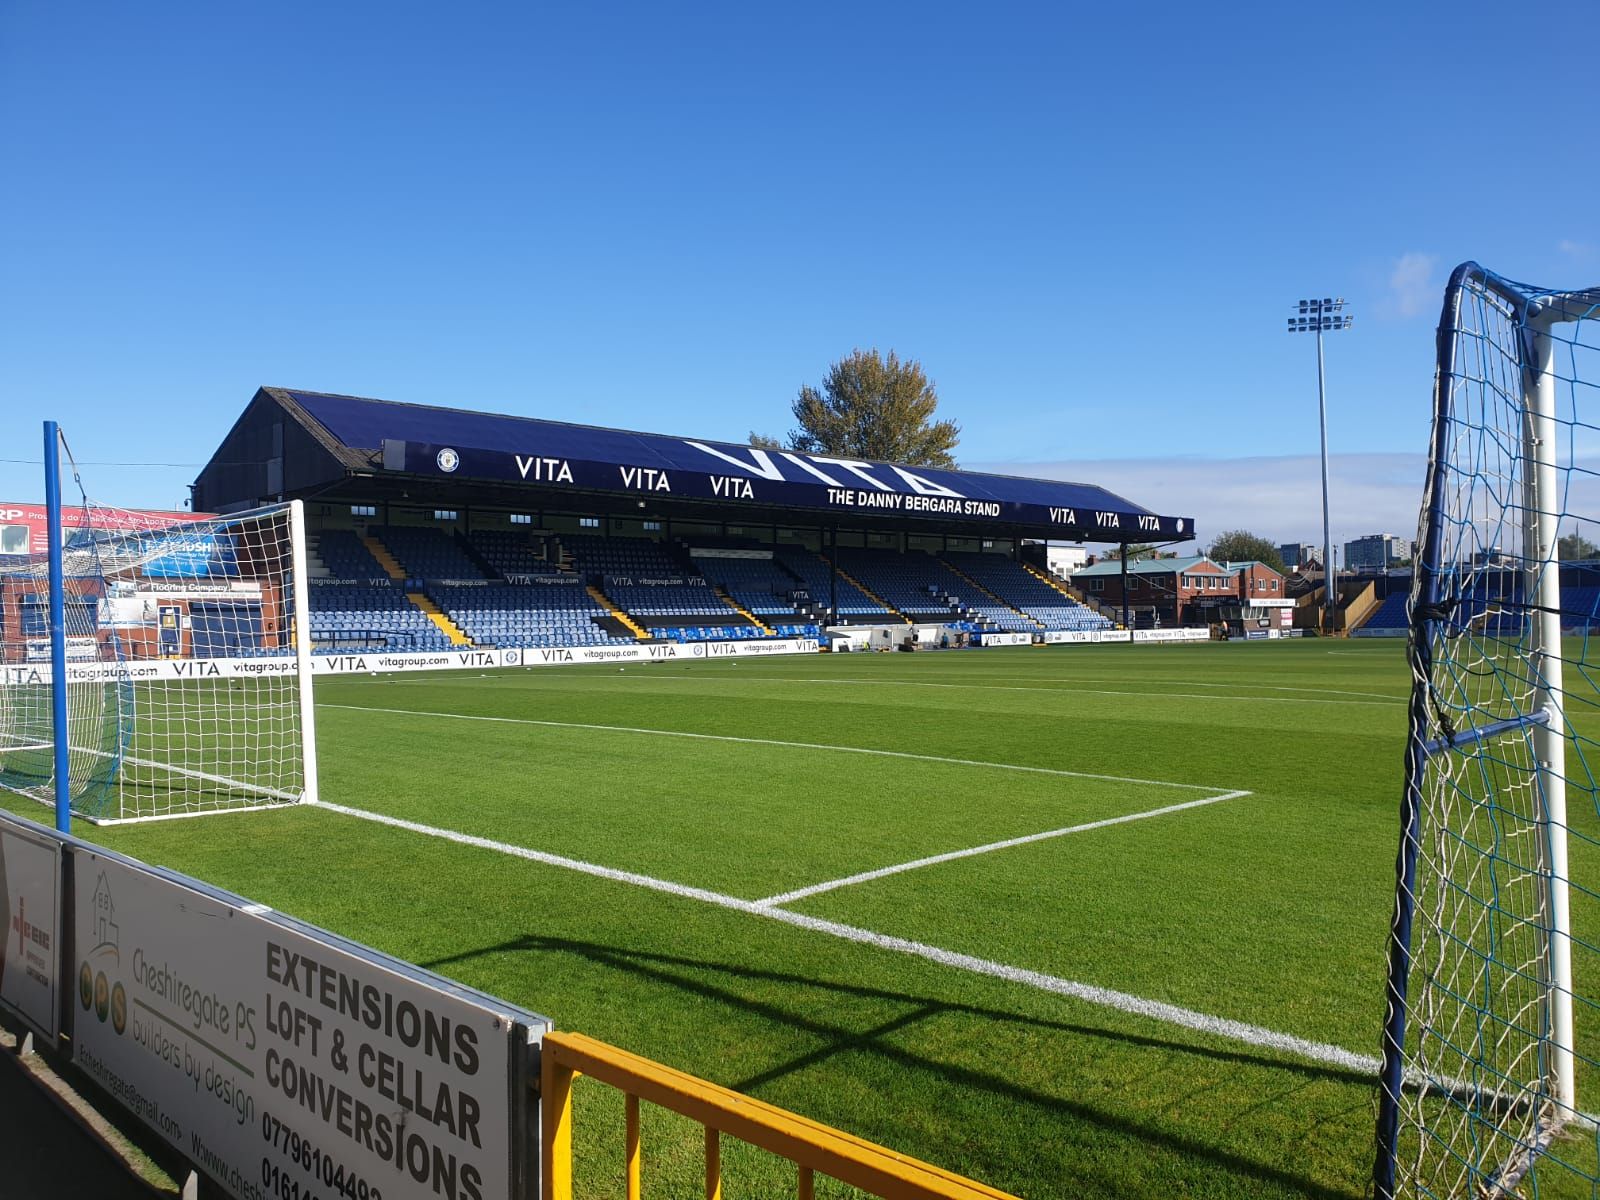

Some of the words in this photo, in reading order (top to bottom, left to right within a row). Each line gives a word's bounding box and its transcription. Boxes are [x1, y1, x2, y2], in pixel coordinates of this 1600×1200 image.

[515, 455, 574, 484] VITA
[683, 440, 968, 499] VITA
[619, 466, 671, 492] VITA
[709, 475, 754, 499] VITA
[827, 488, 854, 506] THE
[857, 491, 902, 509] DANNY
[904, 495, 963, 514] BERGARA
[964, 501, 1000, 518] STAND
[1049, 507, 1076, 525] VITA
[1095, 511, 1120, 528] VITA
[1138, 515, 1160, 531] VITA
[308, 577, 358, 586] itagroup.com
[369, 578, 391, 587] VITA
[507, 575, 531, 585] VITA
[612, 577, 633, 586] VITA
[639, 578, 683, 586] vitagroup.com
[688, 578, 707, 587] VITA
[792, 591, 809, 599] VITA
[985, 635, 1002, 645] VITA
[1071, 632, 1087, 641] VITA
[1135, 631, 1148, 640] VITA
[649, 645, 677, 657] VITA
[711, 643, 738, 655] VITA
[743, 642, 787, 654] vitagroup.com
[796, 640, 819, 651] VITA
[459, 653, 494, 666] VITA
[541, 649, 574, 662] VITA
[583, 649, 639, 660] vitagroup.com
[233, 662, 315, 674] vitagroup.c
[326, 656, 367, 671] VITA
[379, 657, 449, 668] vitagroup.com
[0, 667, 42, 684] ITA
[66, 667, 158, 681] itagroup.com
[172, 662, 221, 677] VITA
[132, 948, 230, 1034] Cheshiregate
[235, 1001, 257, 1051] PS
[266, 941, 480, 1076] EXTENSIONS
[132, 1008, 181, 1069] builders
[184, 1042, 200, 1093] by
[205, 1060, 255, 1125] design
[265, 993, 323, 1058] LOFT
[331, 1028, 349, 1075] &
[358, 1043, 482, 1150] CELLAR
[265, 1048, 483, 1200] CONVERSIONS
